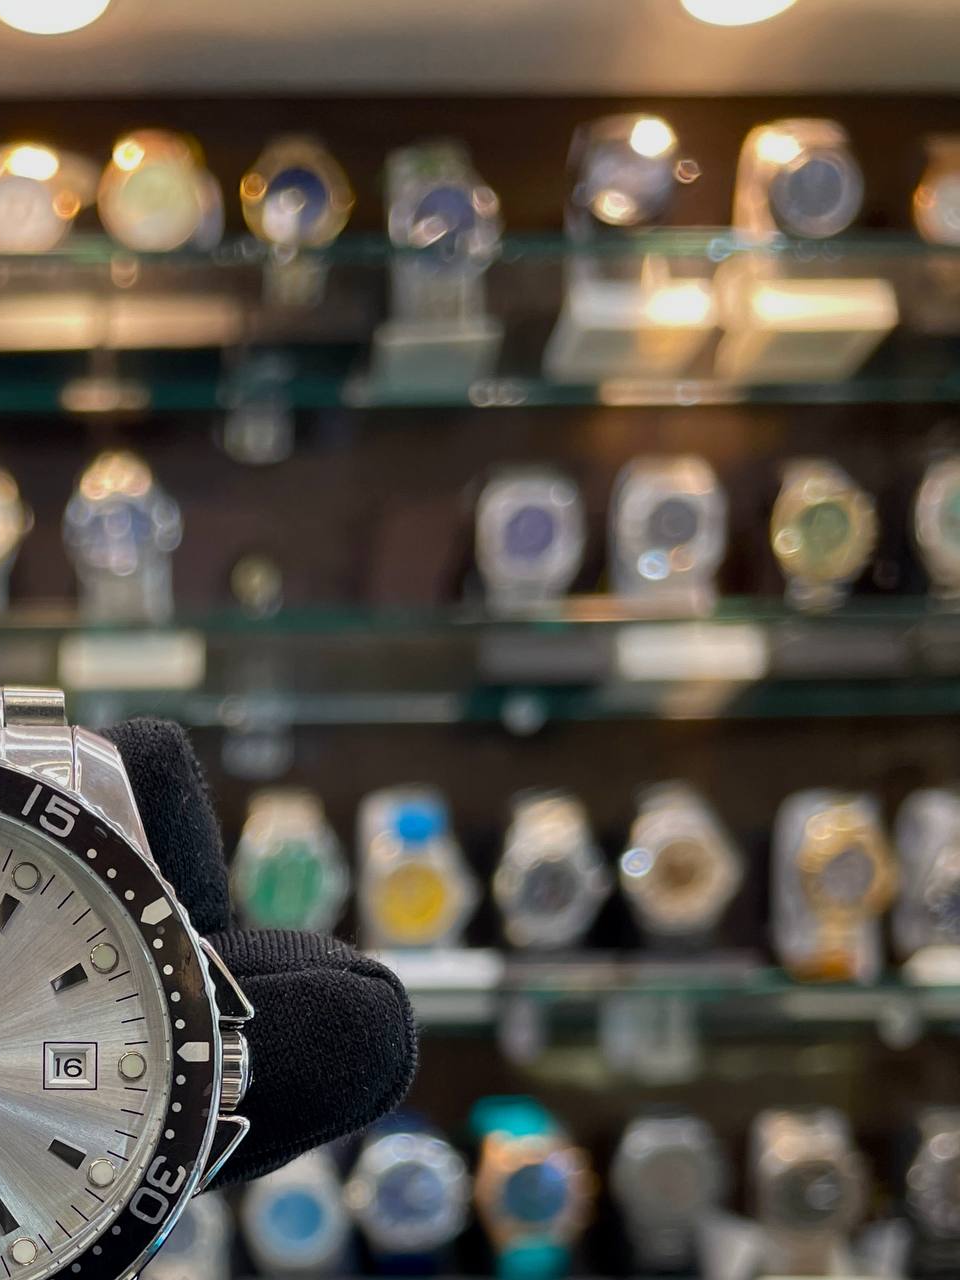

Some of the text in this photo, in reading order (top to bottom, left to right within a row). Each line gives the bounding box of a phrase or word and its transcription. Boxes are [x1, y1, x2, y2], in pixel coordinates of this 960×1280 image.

[21, 783, 81, 838] 15
[55, 1057, 83, 1077] 16
[129, 1155, 186, 1225] 30
